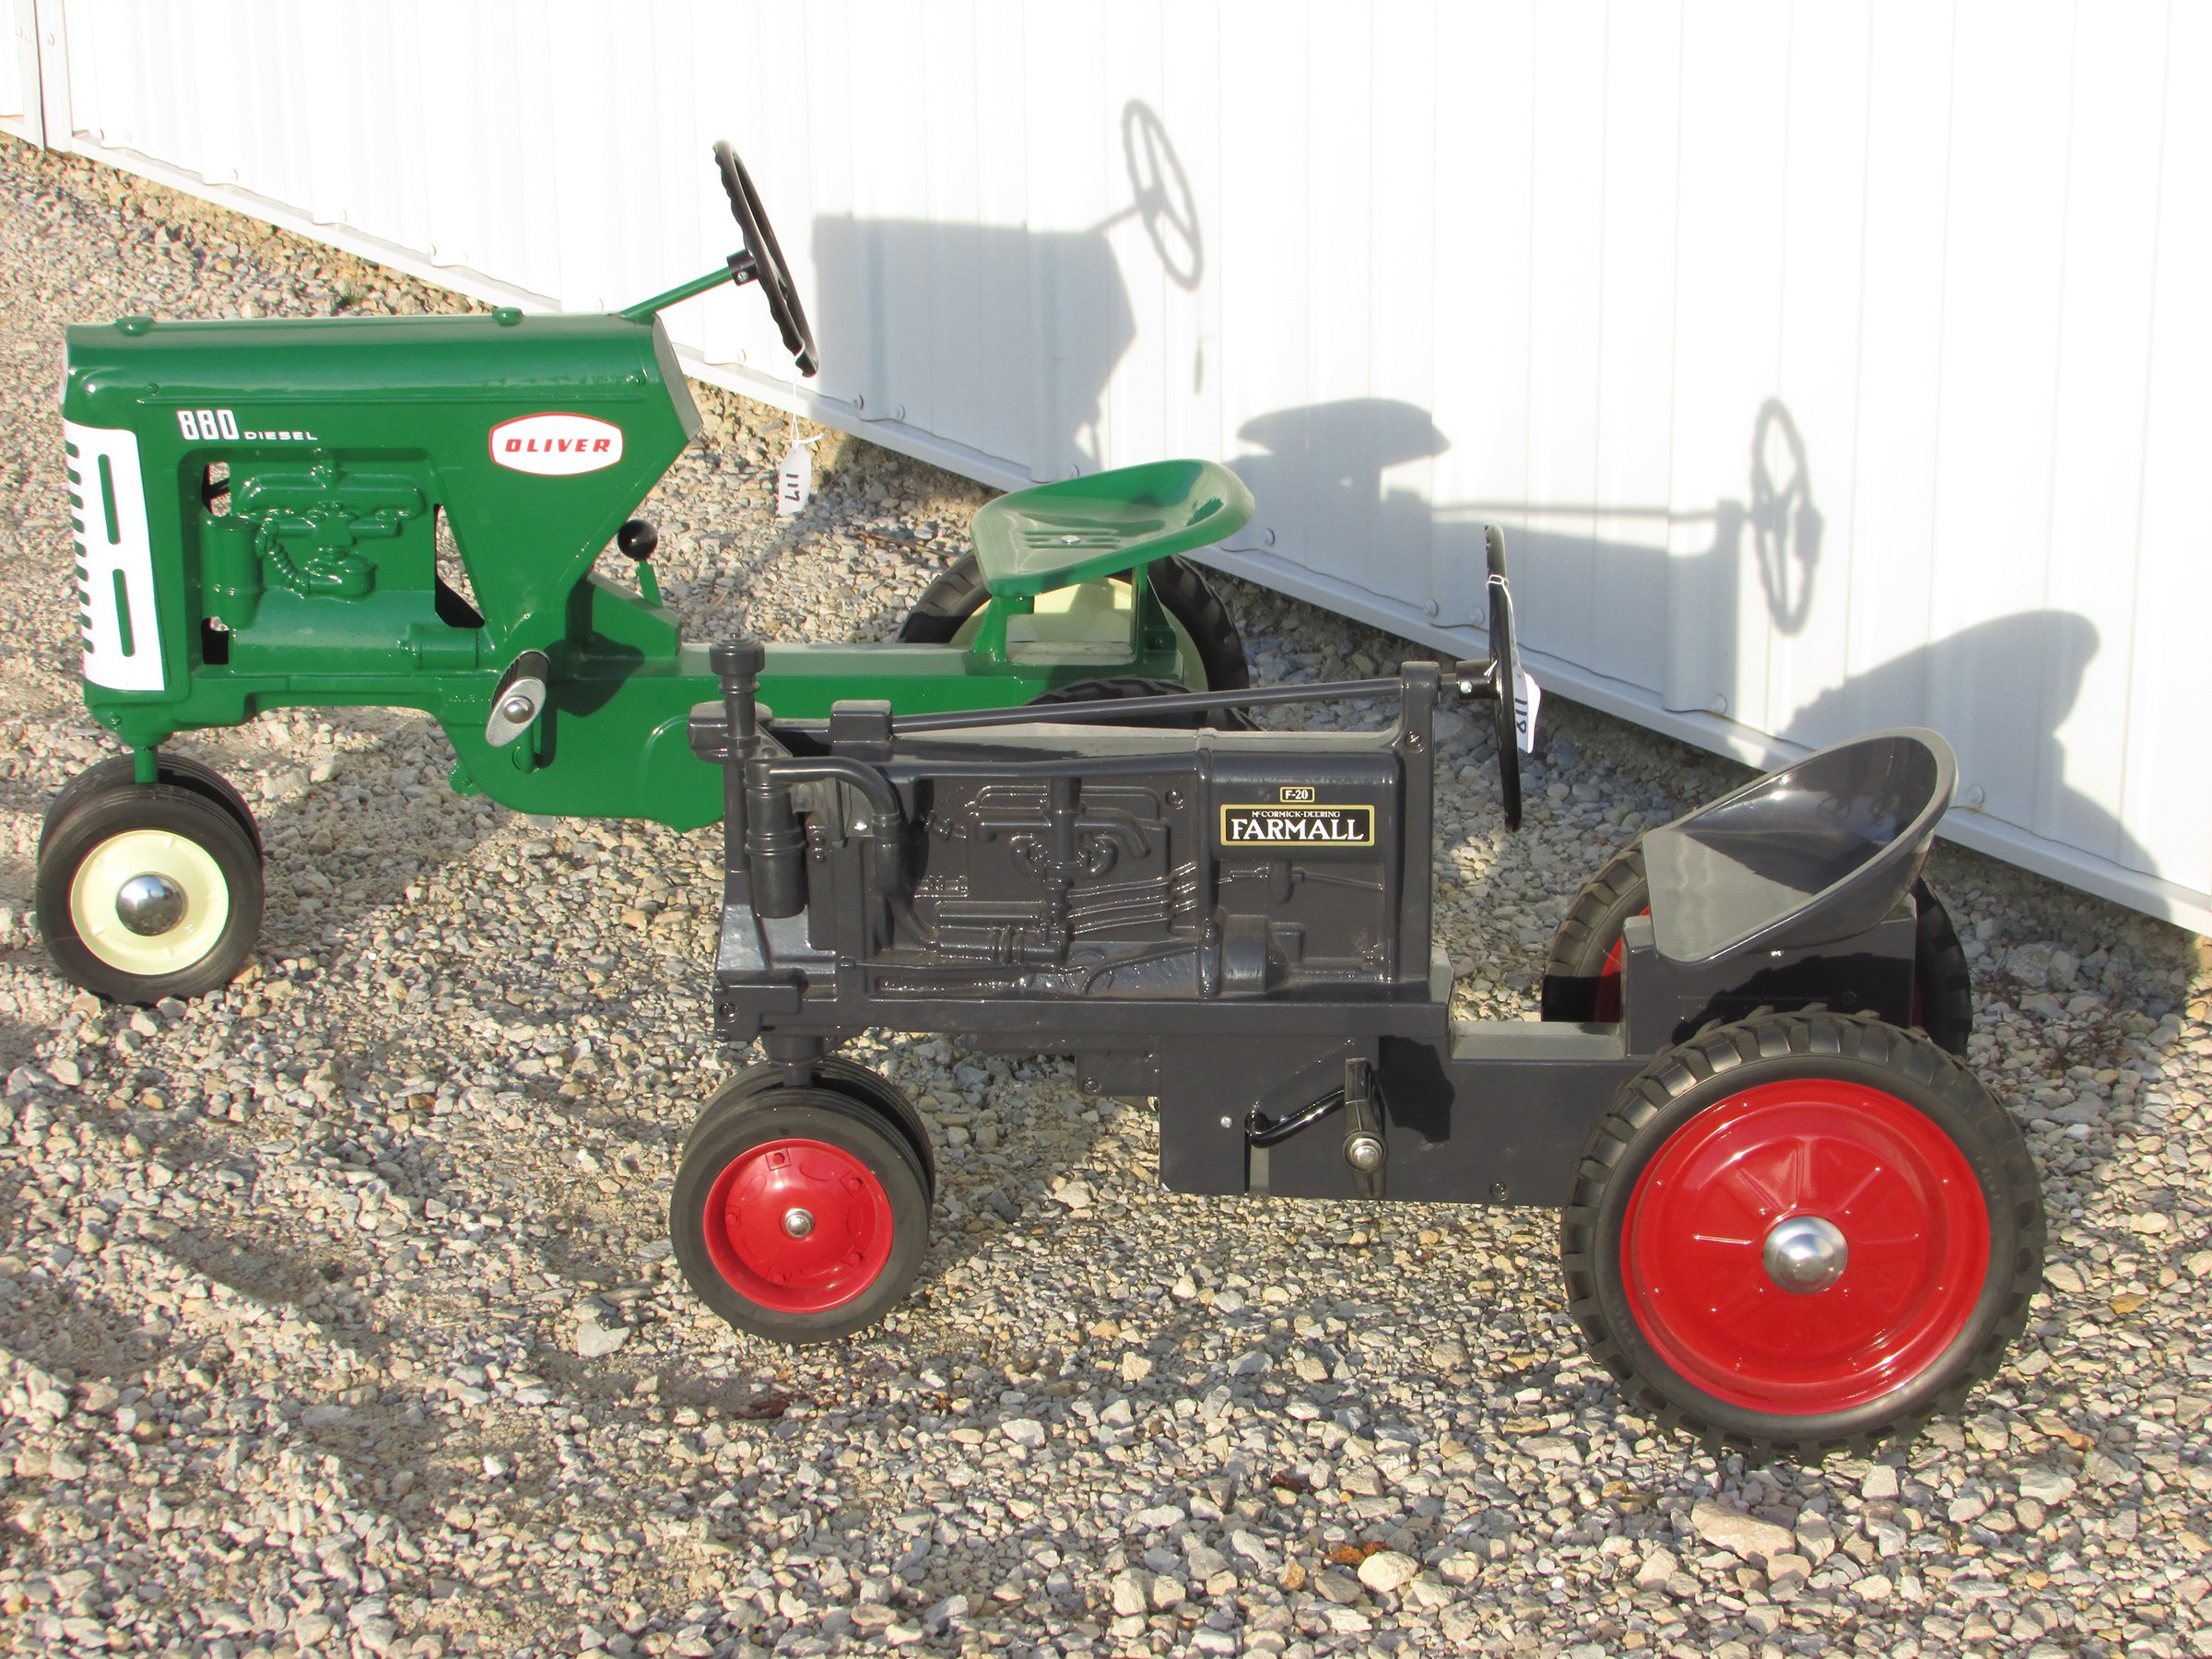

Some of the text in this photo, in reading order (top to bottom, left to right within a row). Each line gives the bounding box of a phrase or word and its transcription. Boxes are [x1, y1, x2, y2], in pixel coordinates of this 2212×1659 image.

[177, 409, 318, 441] 880 DIESEL
[505, 439, 611, 453] OLIVER
[784, 473, 800, 501] 117
[1285, 789, 1309, 800] F-20
[1230, 818, 1364, 841] FARMALL
